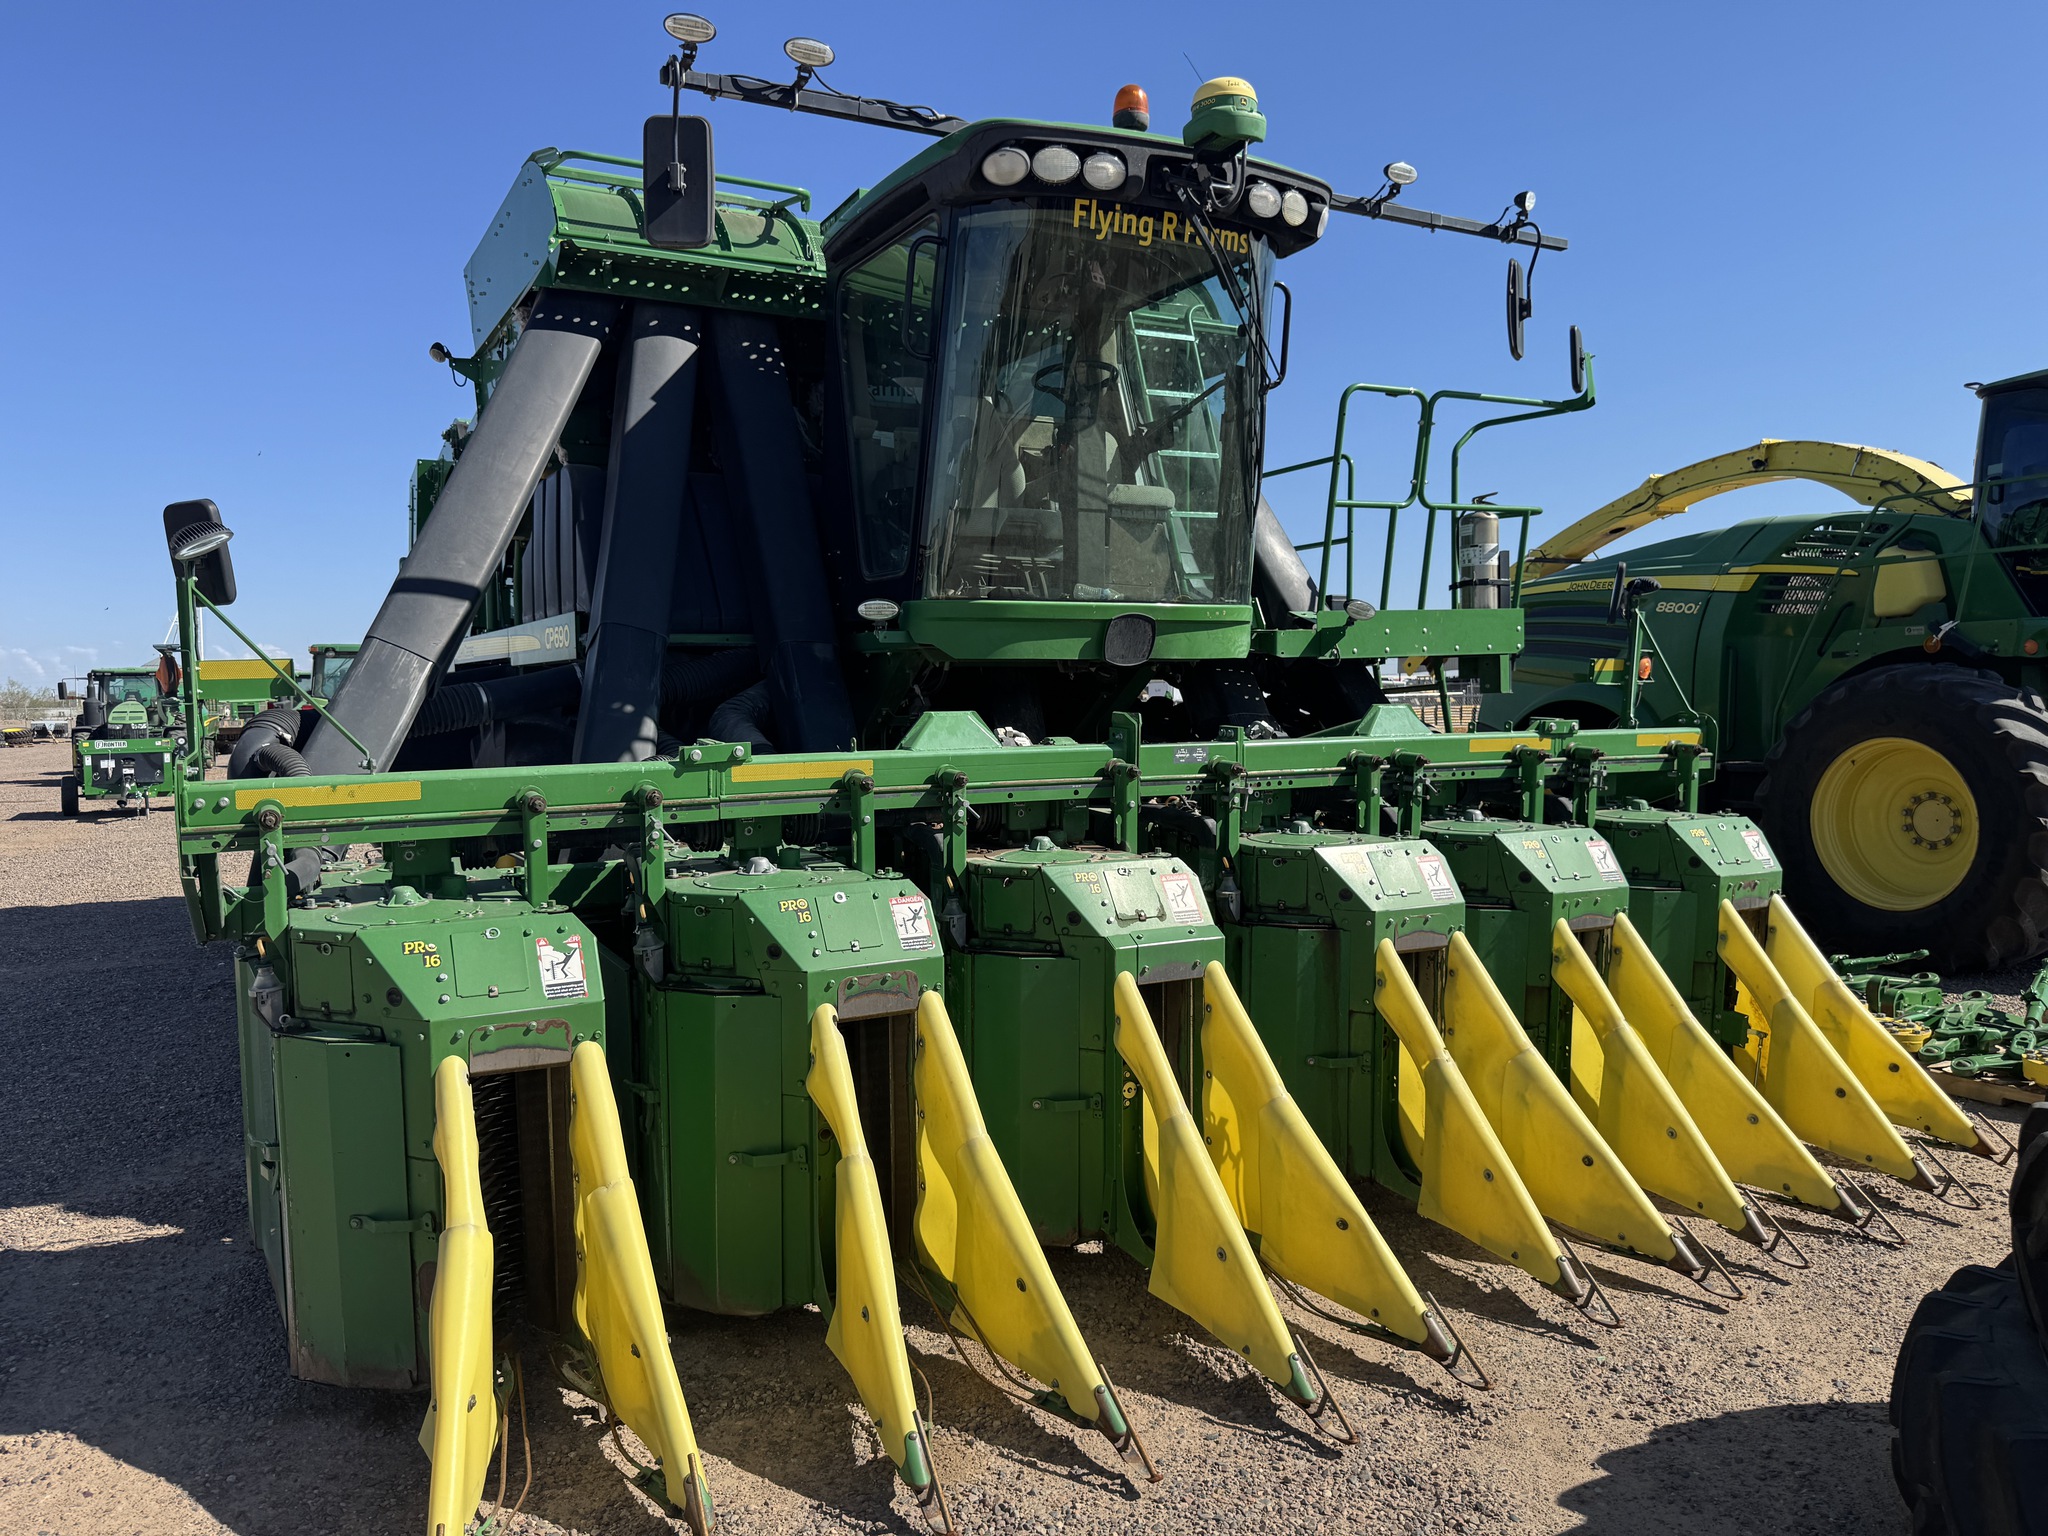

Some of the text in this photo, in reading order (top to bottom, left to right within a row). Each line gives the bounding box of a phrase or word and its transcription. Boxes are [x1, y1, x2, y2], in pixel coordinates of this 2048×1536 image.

[1073, 198, 1154, 247] Flying
[1162, 210, 1178, 242] R
[1566, 580, 1614, 592] JOHN DEER
[1655, 601, 1702, 615] 8800i
[544, 624, 570, 650] CP690
[1522, 840, 1540, 850] PRO
[1535, 849, 1545, 859] 16
[1074, 872, 1098, 883] PRO
[1089, 883, 1102, 894] 16
[779, 898, 808, 913] PRO
[897, 896, 922, 904] DANGER
[798, 911, 812, 923] 16
[424, 954, 441, 968] 16
